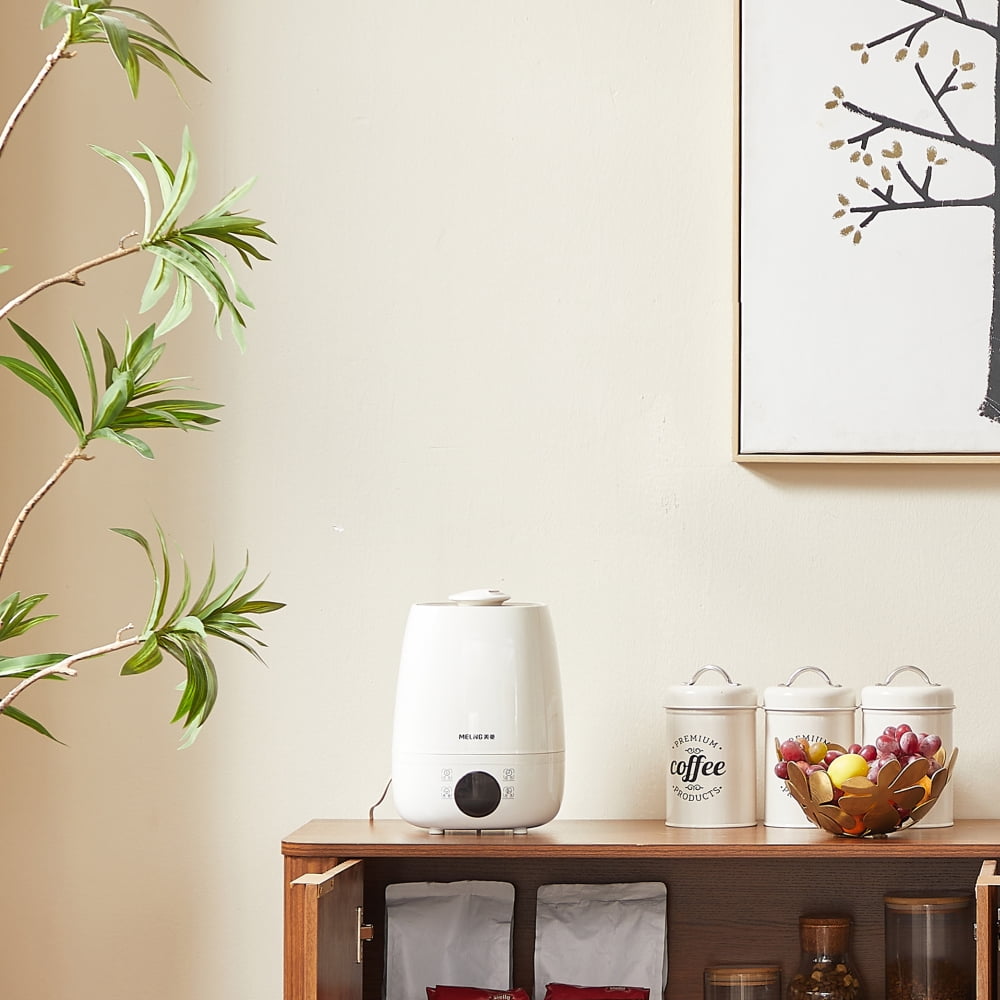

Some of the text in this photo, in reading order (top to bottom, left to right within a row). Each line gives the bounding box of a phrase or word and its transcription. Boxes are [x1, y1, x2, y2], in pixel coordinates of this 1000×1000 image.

[674, 734, 719, 749] PREMIUM
[670, 754, 727, 783] coffee
[673, 785, 721, 802] PRODUCTS
